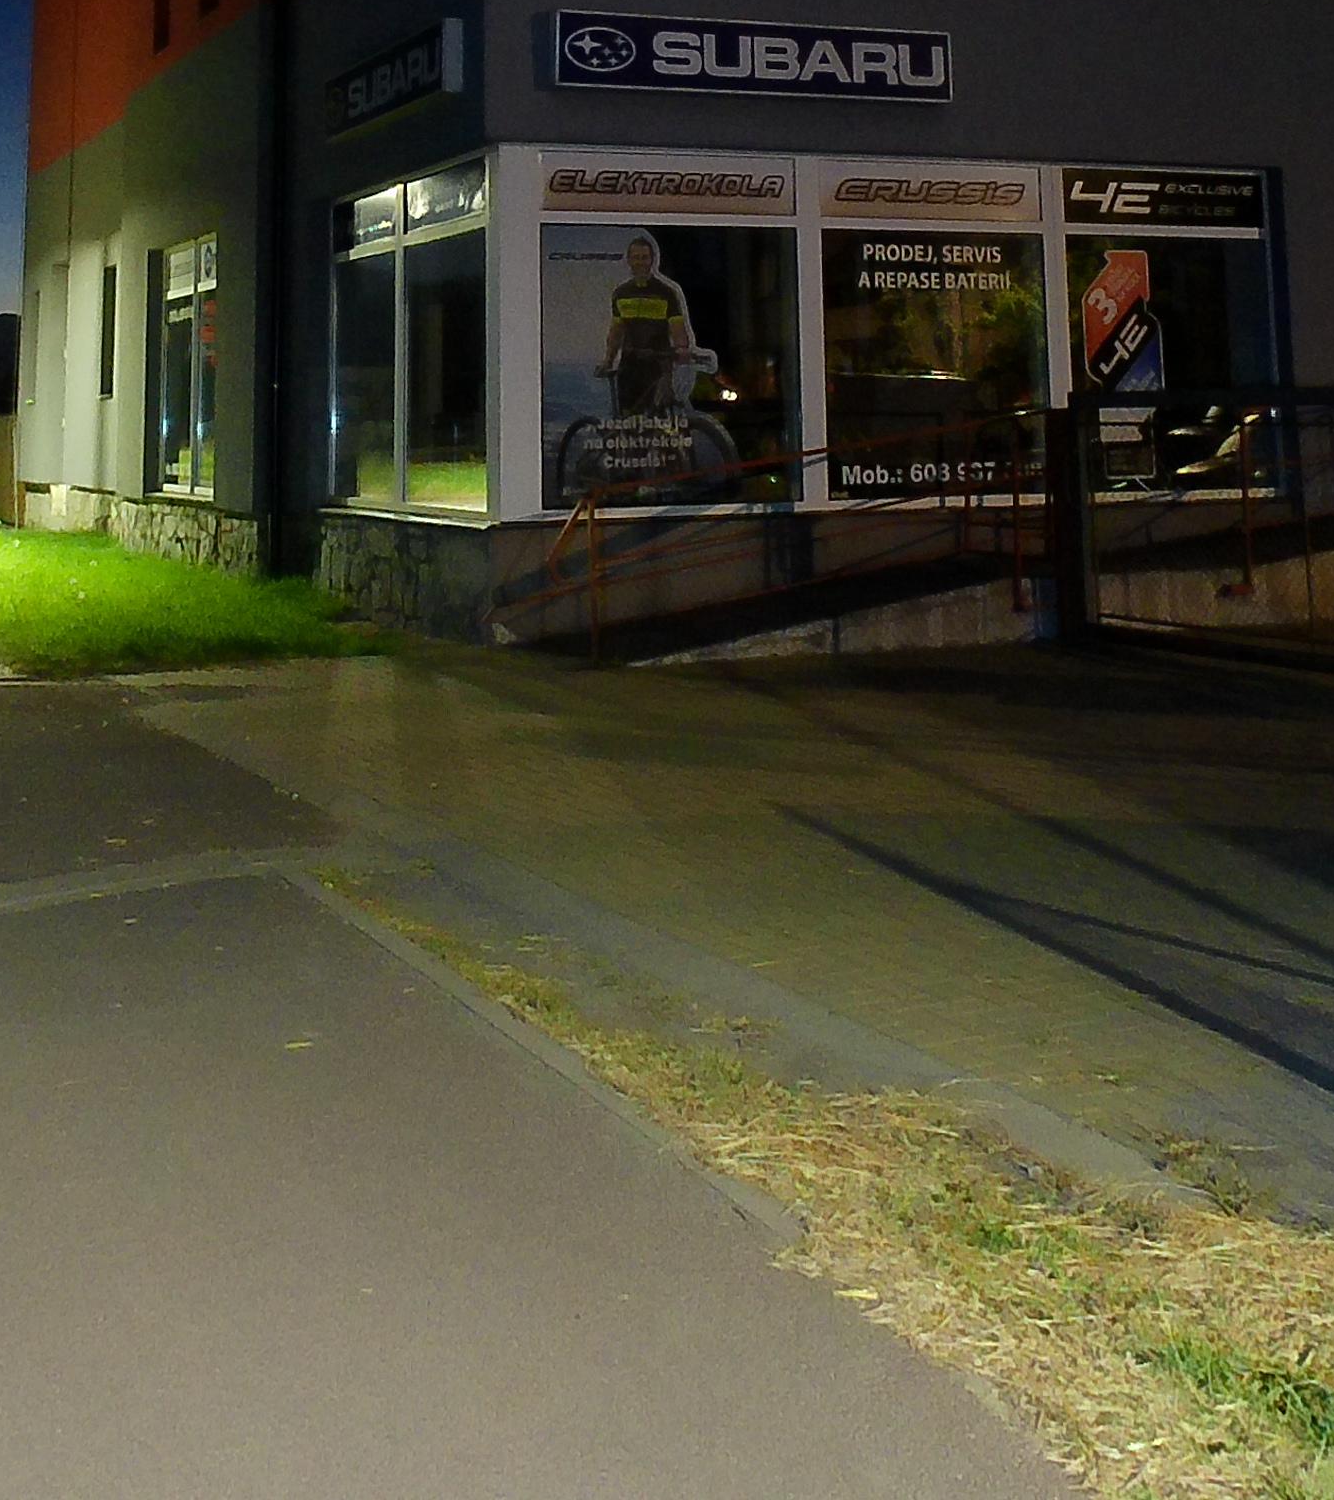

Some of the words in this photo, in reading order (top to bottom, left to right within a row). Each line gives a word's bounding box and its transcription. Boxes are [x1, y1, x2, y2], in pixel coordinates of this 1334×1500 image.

[653, 30, 946, 87] SUBARU
[347, 37, 441, 118] SUBARU
[549, 168, 785, 198] ELEKTROKOLA
[1164, 182, 1254, 197] EXCLUSIVE
[862, 243, 938, 265] PRODEJ,
[942, 244, 1002, 263] SERVIS
[858, 271, 871, 289] A
[874, 271, 940, 289] REPASE
[1087, 287, 1118, 324] 3
[841, 464, 904, 485] Mob.:
